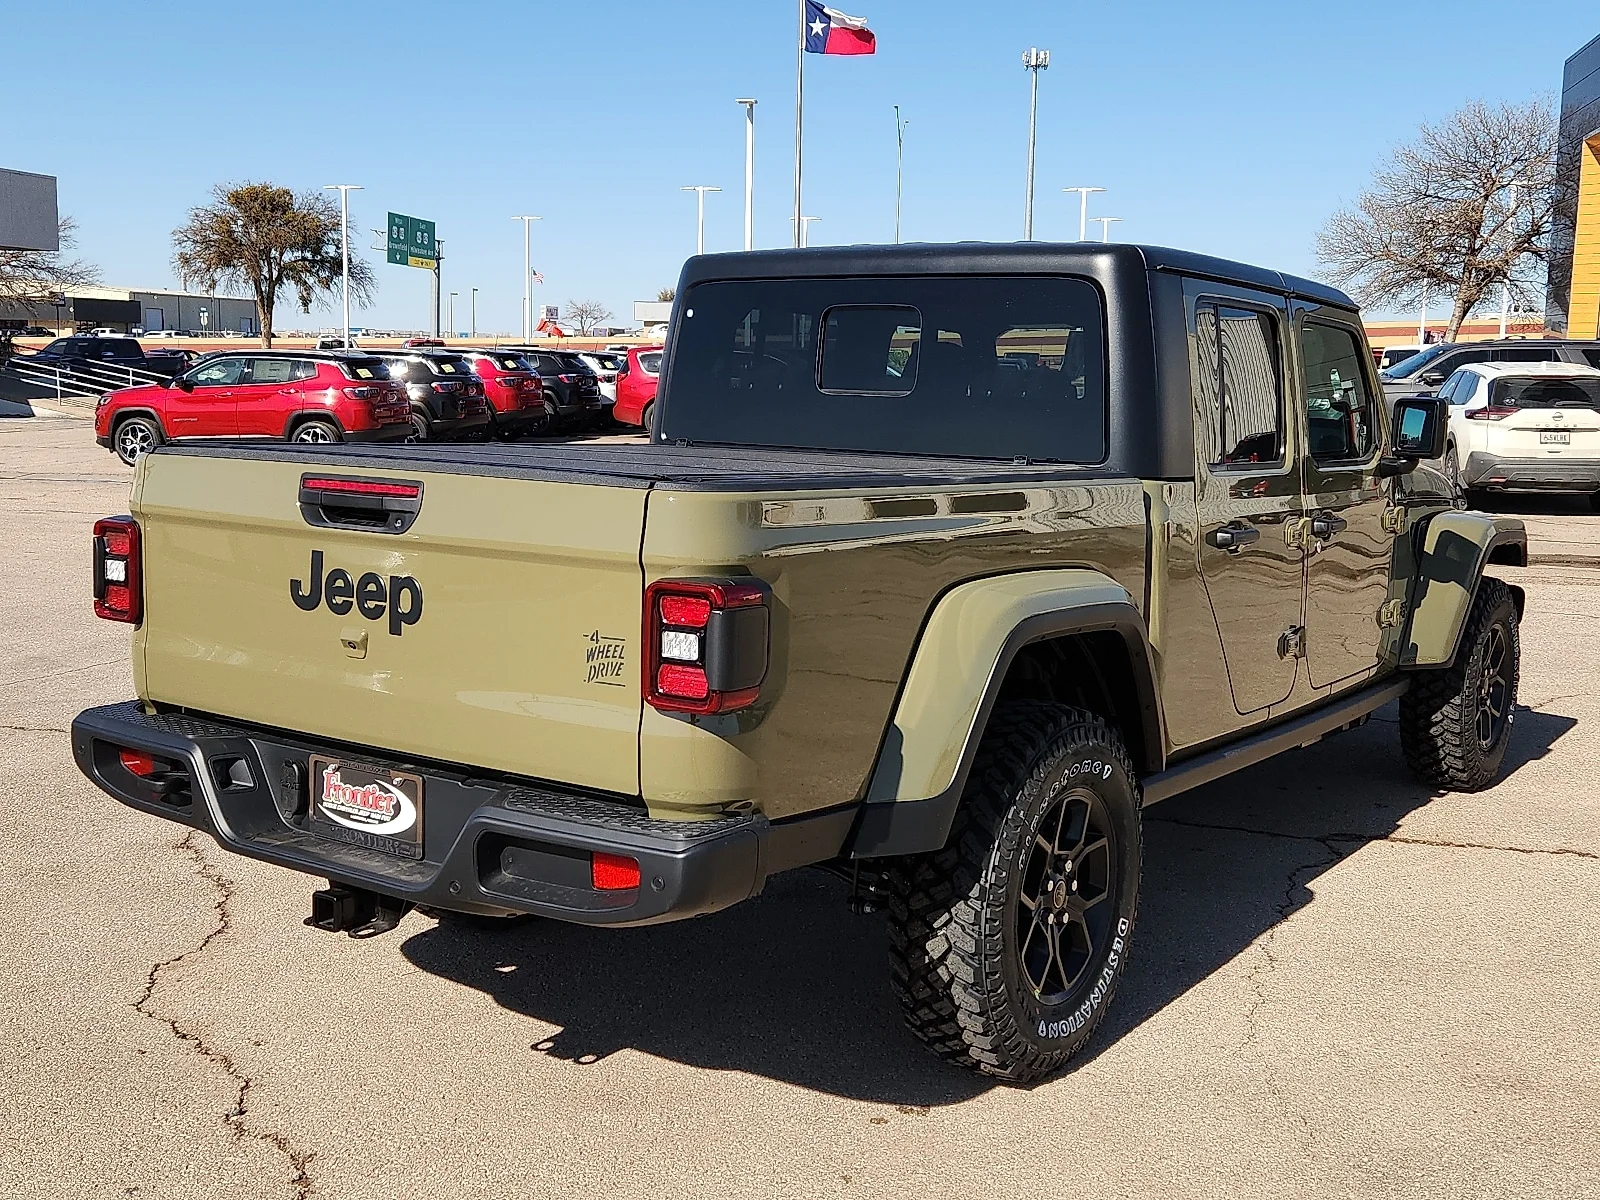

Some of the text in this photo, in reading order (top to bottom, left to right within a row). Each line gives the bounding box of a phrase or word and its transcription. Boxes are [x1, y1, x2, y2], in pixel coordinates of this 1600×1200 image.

[290, 549, 423, 636] Jeep
[586, 644, 625, 663] WHEEL
[590, 629, 600, 645] 4
[587, 661, 625, 683] DRIVE
[323, 769, 396, 815] Frontier
[1048, 917, 1129, 1039] DESTINATION
